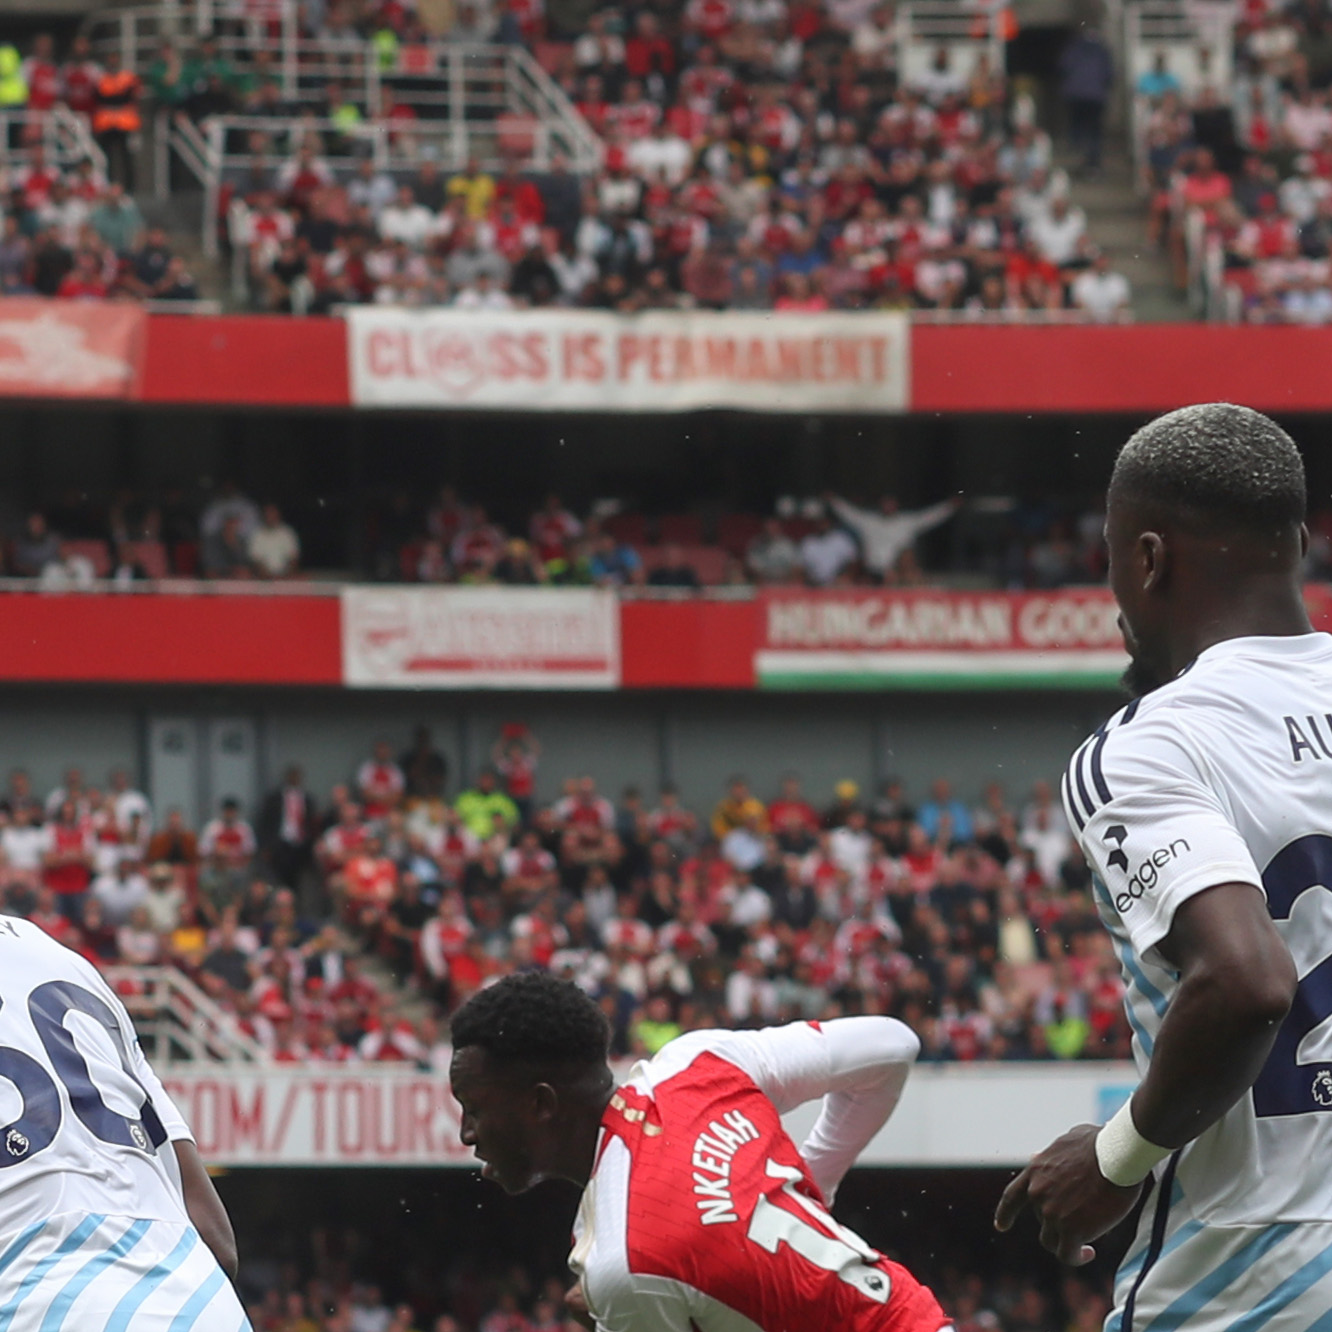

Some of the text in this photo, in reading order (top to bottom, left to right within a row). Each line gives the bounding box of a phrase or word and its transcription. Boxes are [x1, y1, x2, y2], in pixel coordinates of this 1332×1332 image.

[562, 332, 606, 384] IS
[617, 334, 888, 386] PERMANENT
[767, 600, 1012, 649] HUNGARIAN
[691, 1108, 762, 1226] NKETIAH
